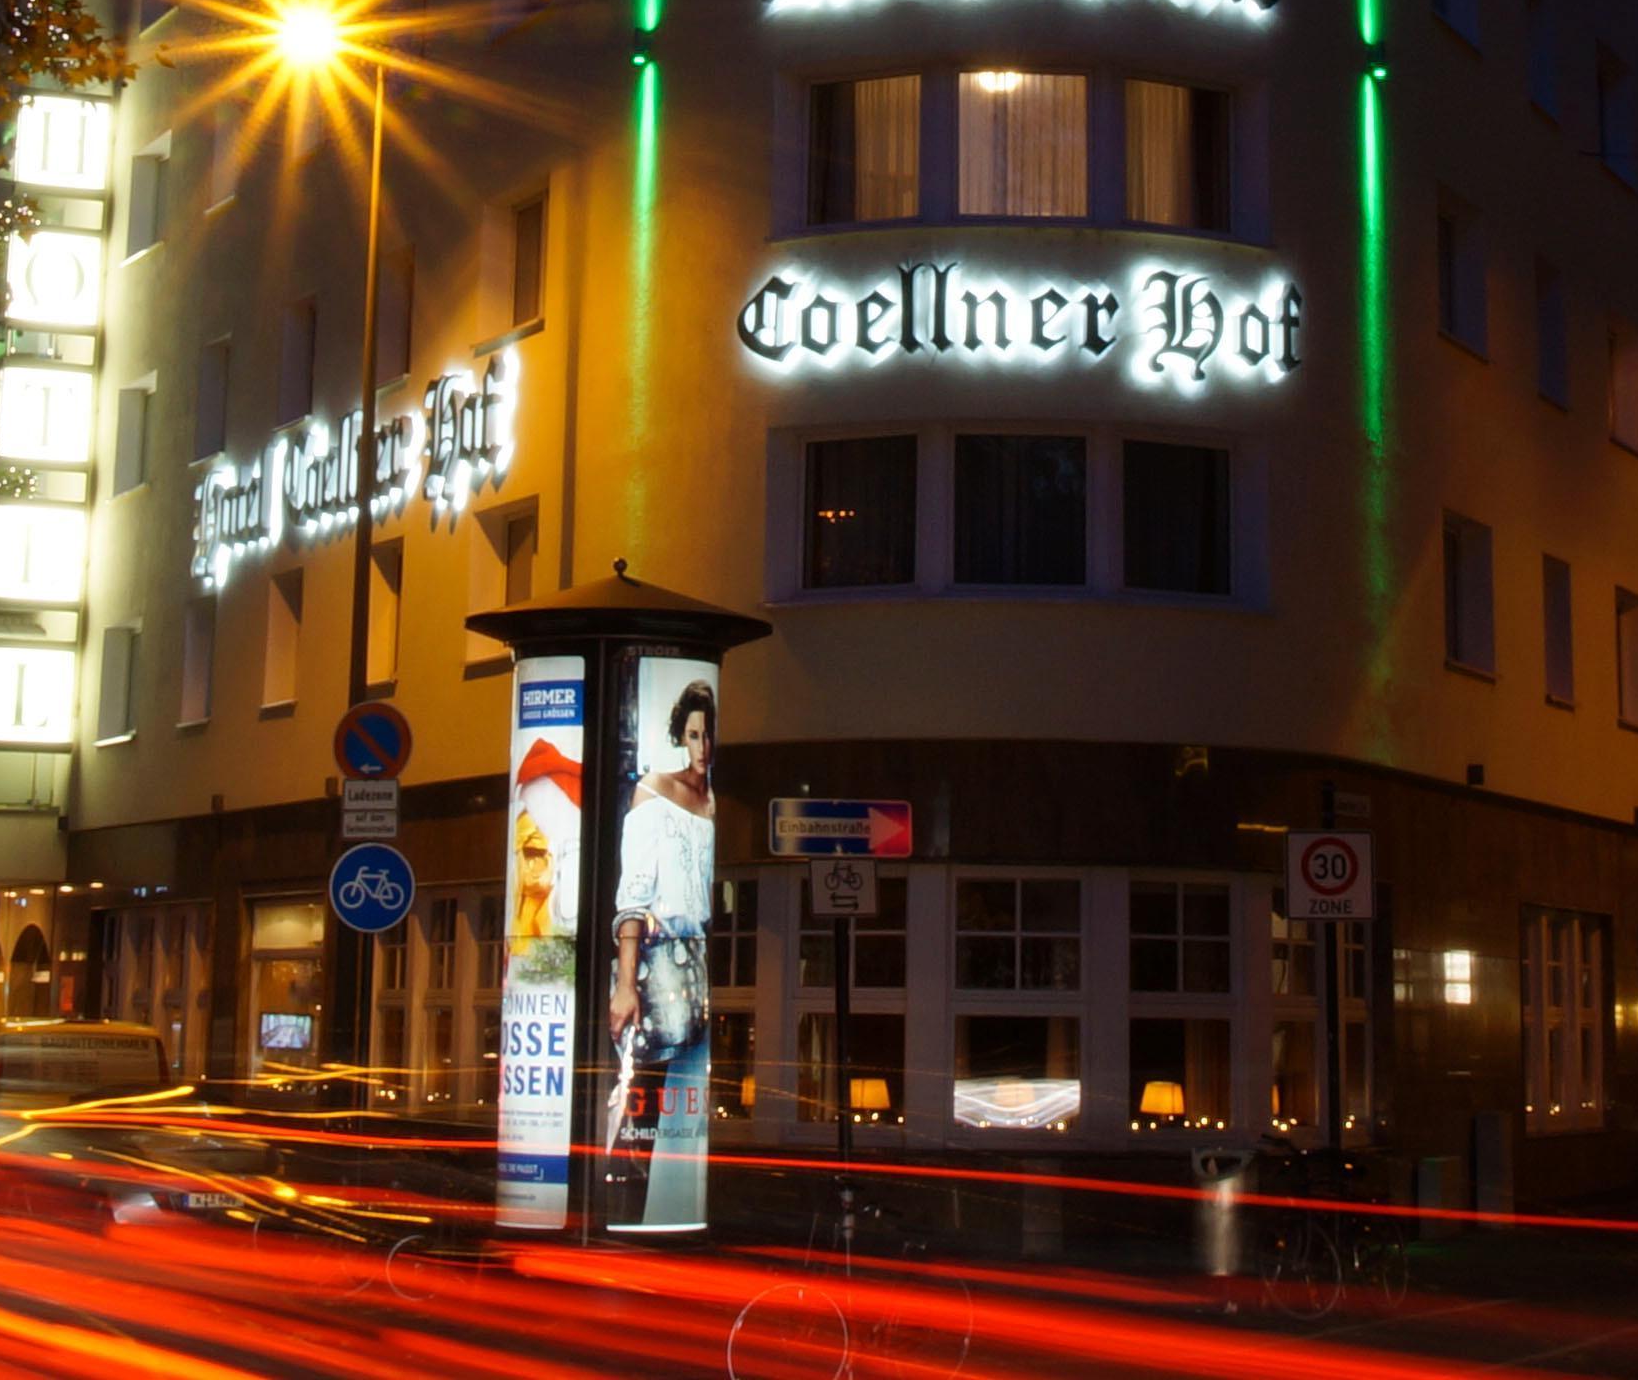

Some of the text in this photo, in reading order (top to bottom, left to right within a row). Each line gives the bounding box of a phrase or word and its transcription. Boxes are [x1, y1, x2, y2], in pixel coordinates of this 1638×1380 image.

[737, 261, 1303, 381] Coellner Hof
[522, 688, 576, 706] HIRMER
[779, 820, 872, 835] Einbahnstraße
[1314, 853, 1346, 880] 30
[1308, 899, 1353, 915] ZONE
